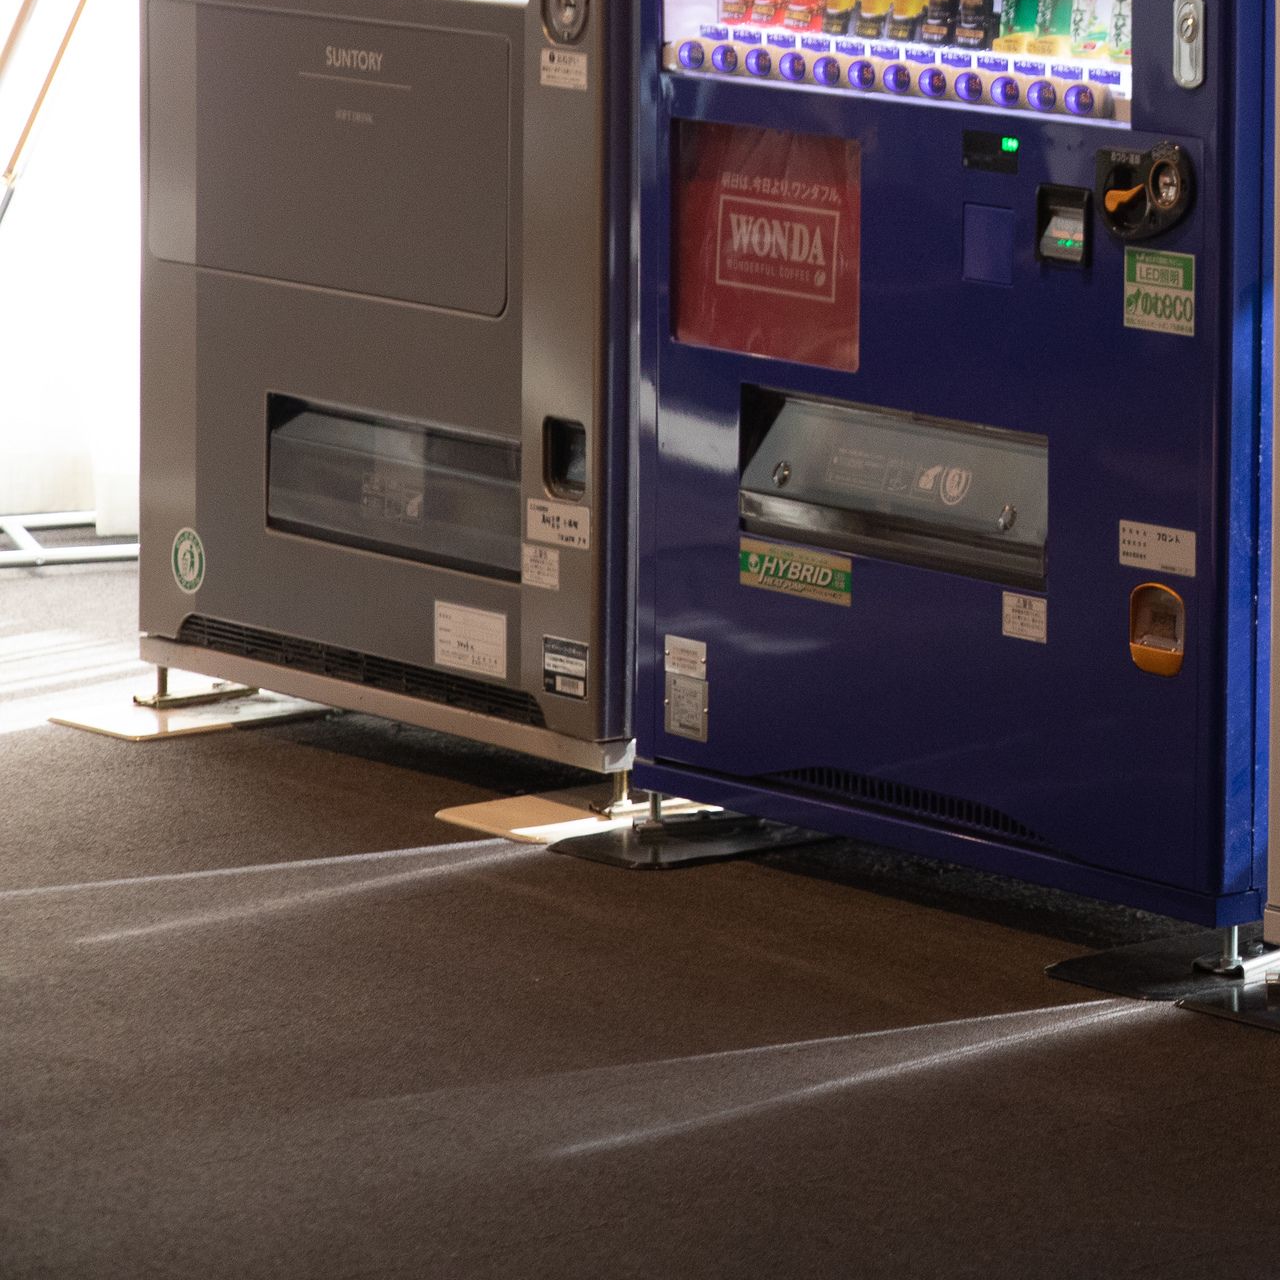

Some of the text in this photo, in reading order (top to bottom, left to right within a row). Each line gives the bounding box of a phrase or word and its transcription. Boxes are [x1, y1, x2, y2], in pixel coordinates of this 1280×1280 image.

[325, 44, 384, 72] SUNTORY
[728, 212, 827, 267] WONDA
[1137, 266, 1181, 287] LED照明
[758, 556, 834, 587] HYBRID
